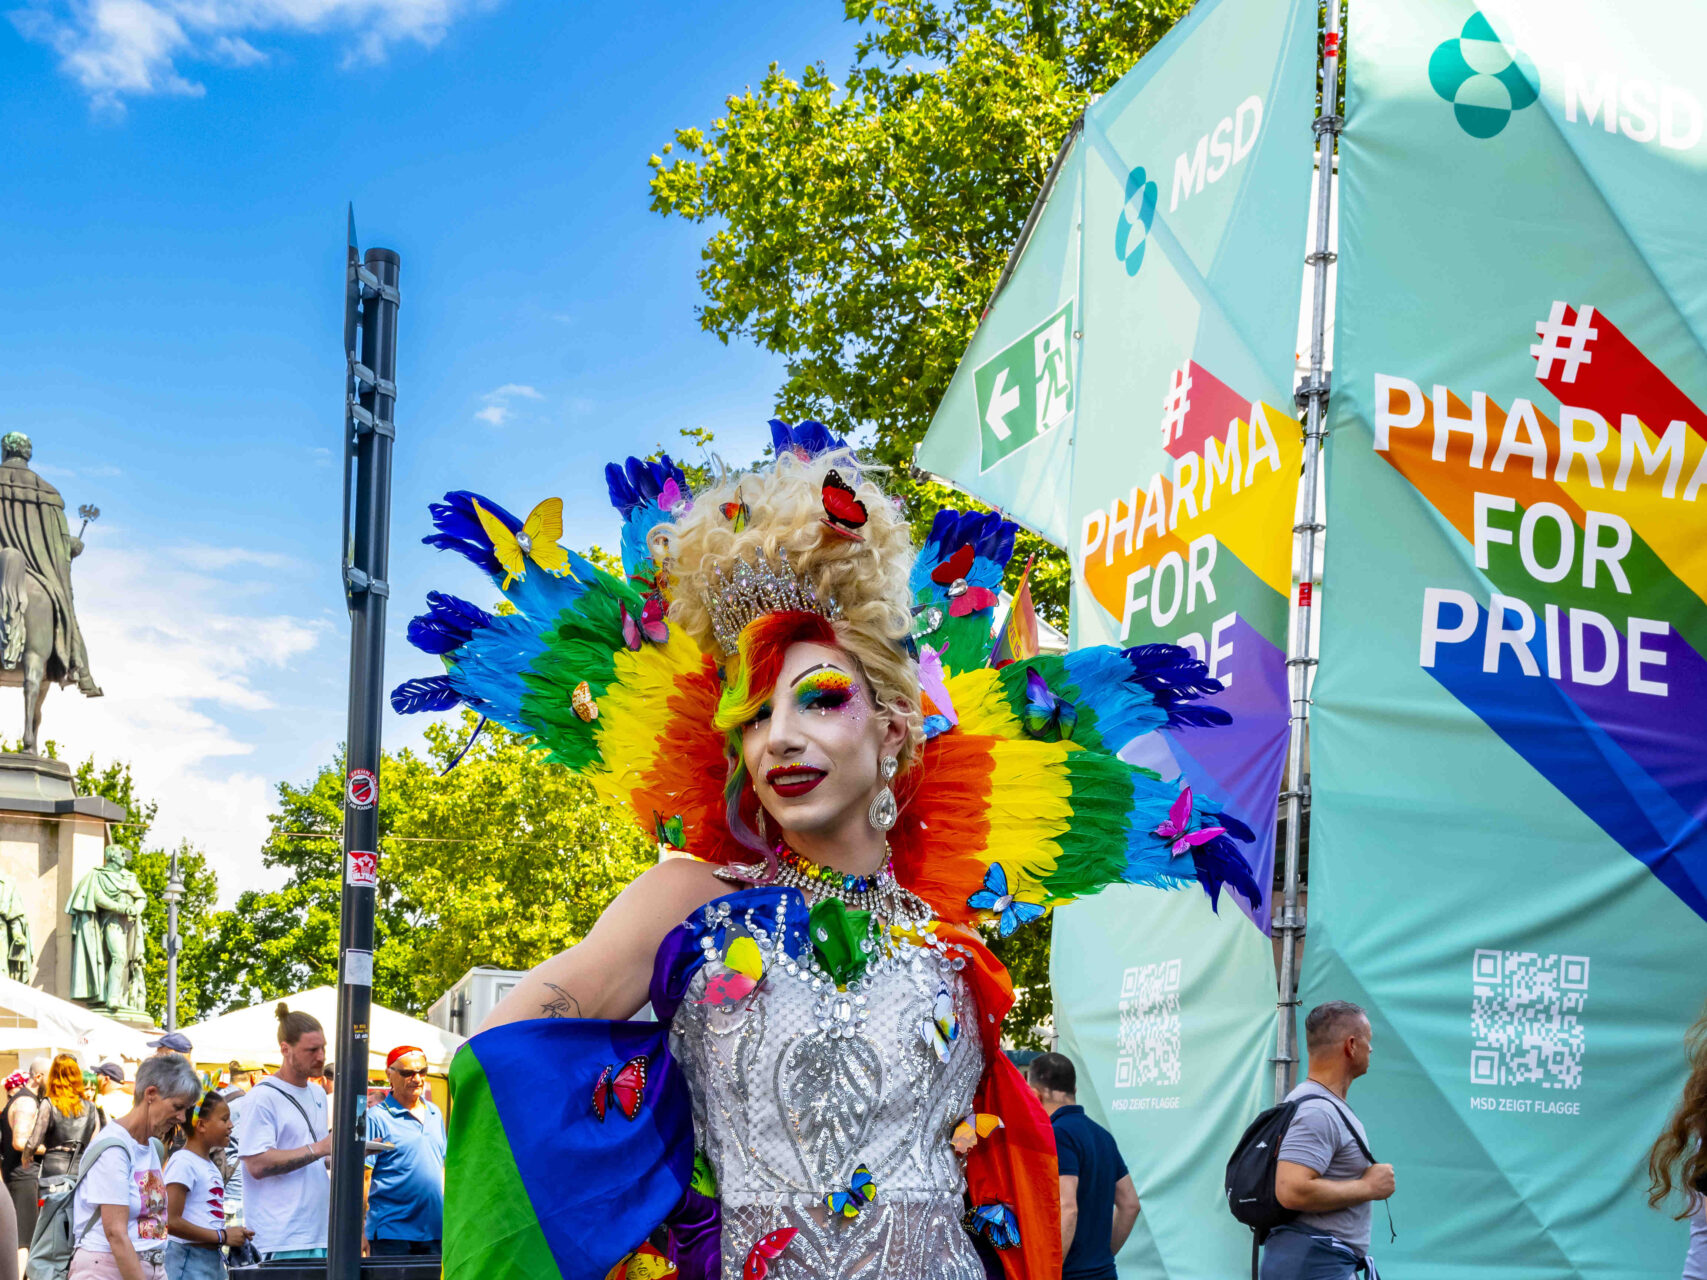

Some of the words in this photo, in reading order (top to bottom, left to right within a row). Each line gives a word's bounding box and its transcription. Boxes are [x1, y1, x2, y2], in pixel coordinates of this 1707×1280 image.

[1169, 94, 1263, 213] MSD
[1564, 62, 1703, 150] MSD
[1530, 300, 1598, 383] #
[1161, 358, 1193, 449] #
[1079, 399, 1281, 577] PHARMA
[1120, 533, 1218, 642] FOR
[1474, 491, 1632, 594] FOR
[1419, 588, 1670, 697] PRIDE
[1112, 1099, 1129, 1111] MSD
[1129, 1097, 1151, 1110] ZEIGT
[1151, 1096, 1181, 1109] FLAGGE
[1470, 1096, 1497, 1110] MSD
[1499, 1098, 1532, 1112] ZEIGT
[1535, 1100, 1581, 1115] FLAGGE
